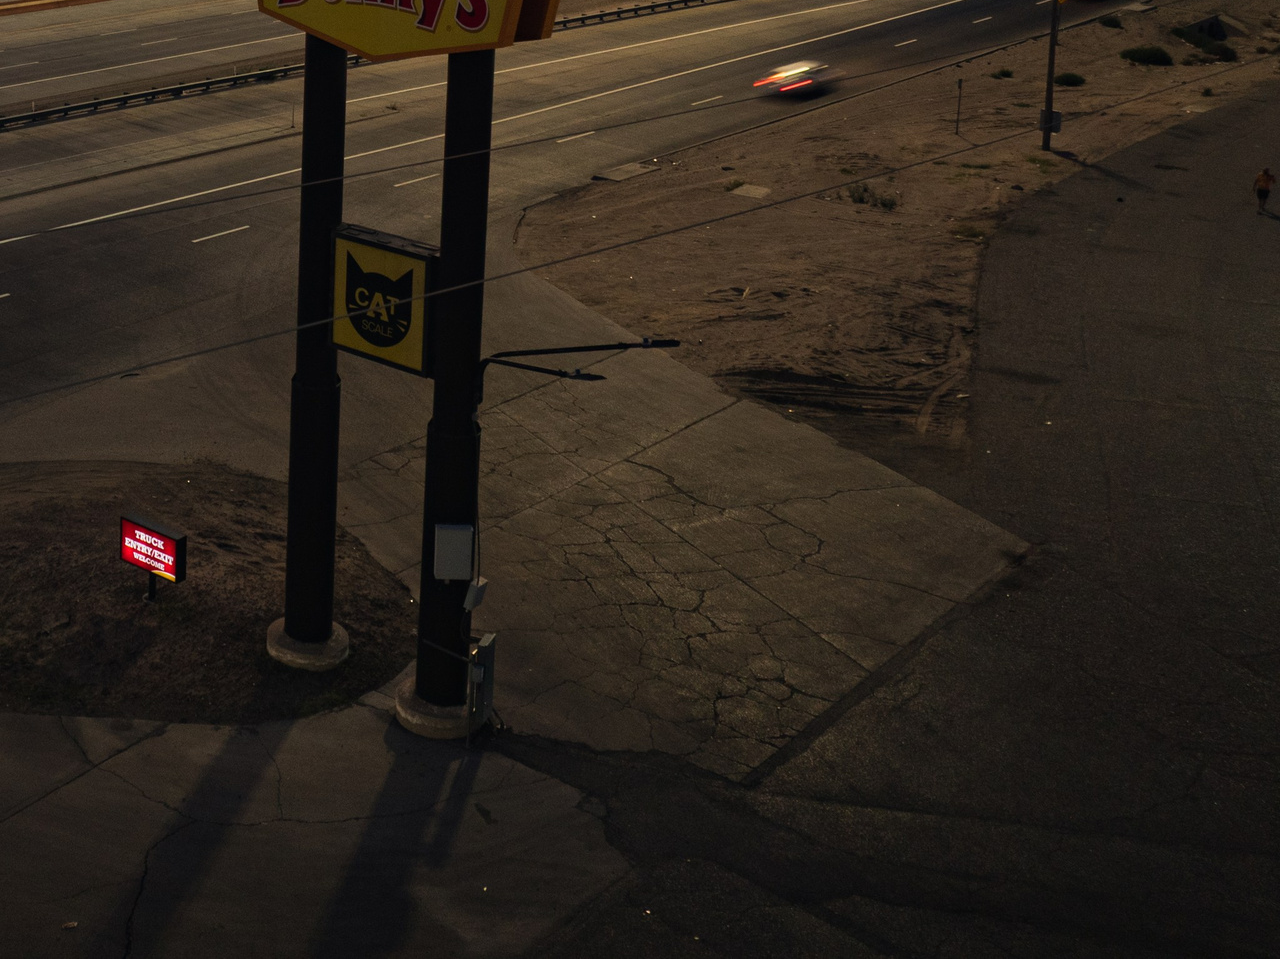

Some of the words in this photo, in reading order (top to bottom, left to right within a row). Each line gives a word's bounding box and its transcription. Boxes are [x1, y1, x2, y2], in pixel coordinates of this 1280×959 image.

[354, 286, 400, 323] CAT
[360, 319, 394, 339] SCALE
[134, 529, 165, 550] TRUCK
[124, 536, 174, 566] ENTRY/EXIT
[132, 551, 166, 572] WELCOME
